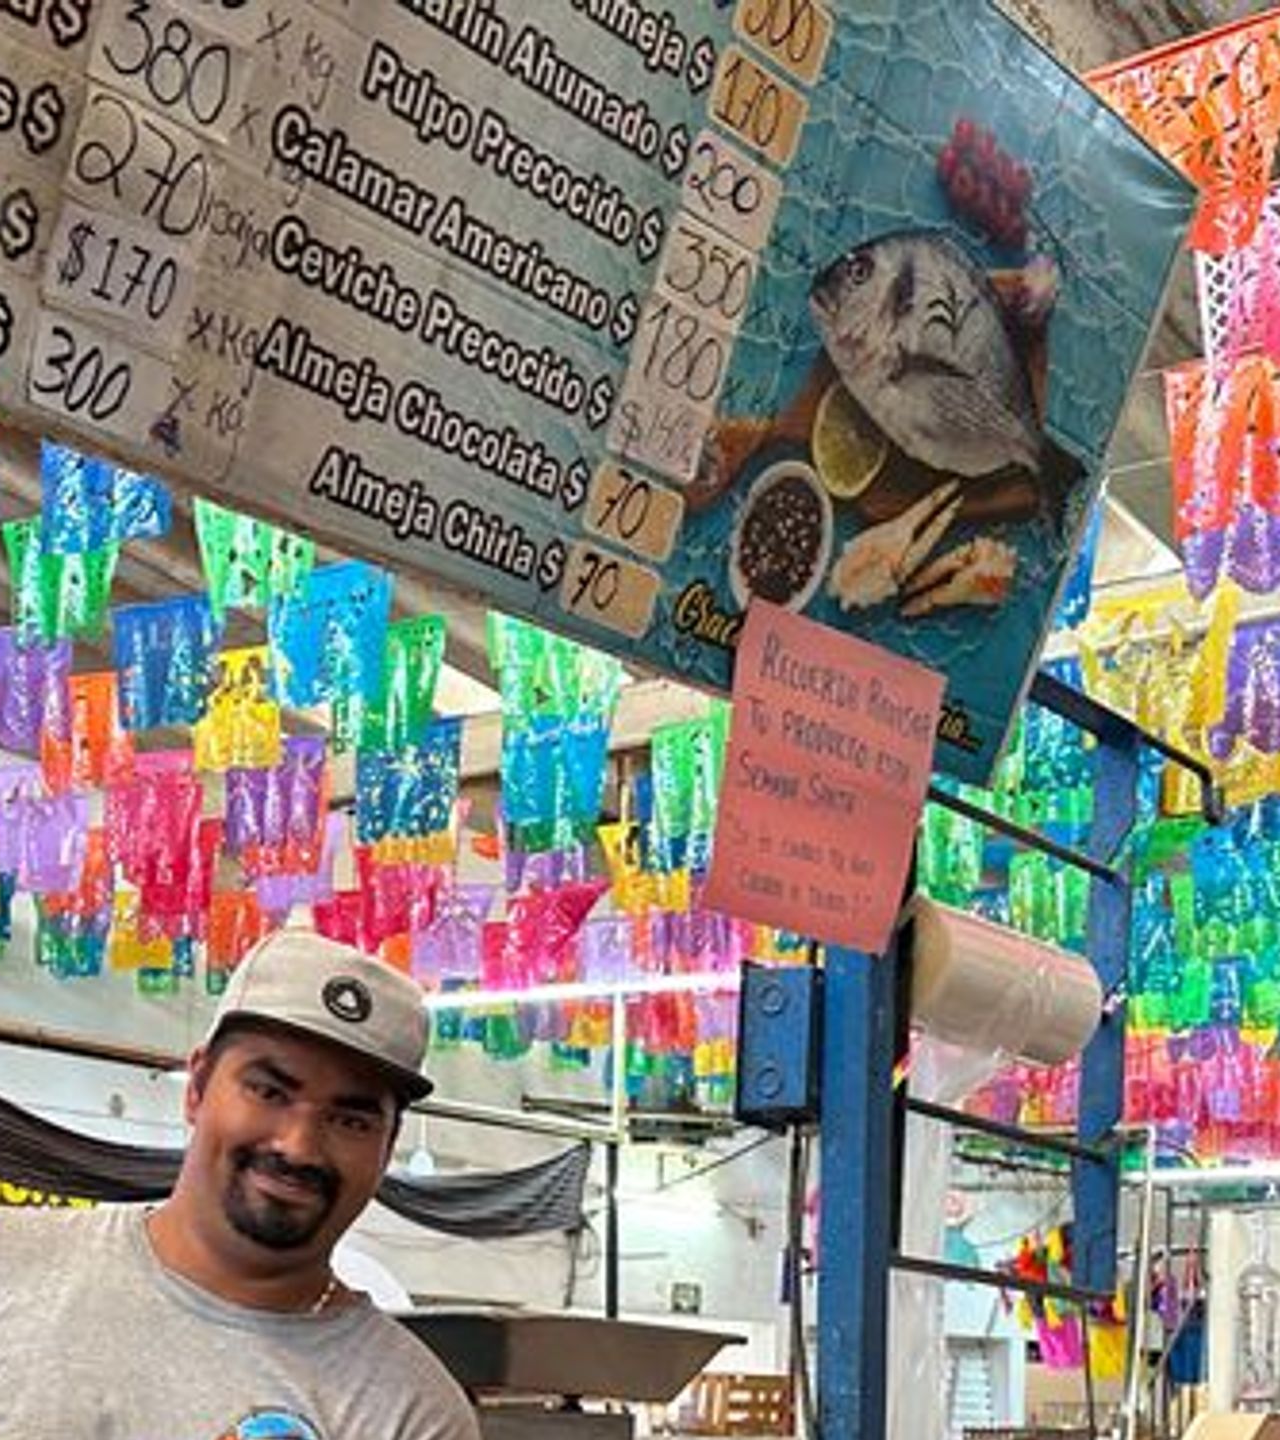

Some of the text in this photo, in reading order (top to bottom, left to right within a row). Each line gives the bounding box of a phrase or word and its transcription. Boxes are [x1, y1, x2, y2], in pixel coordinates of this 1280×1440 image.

[22, 83, 65, 153] $
[101, 2, 230, 125] 380
[397, 0, 507, 66] arlin
[503, 24, 661, 161] Ahumado
[660, 123, 690, 180] $
[686, 35, 718, 95] $
[270, 103, 437, 238] Calamar
[432, 199, 611, 330] Americano
[610, 291, 639, 348] $
[642, 301, 723, 401] 180
[361, 40, 751, 319] Pulpo Precocido $ 350
[59, 217, 178, 320] $170
[268, 214, 420, 333] Ceviche
[422, 295, 586, 417] Precocido
[586, 373, 615, 431] $
[33, 325, 131, 420] 300
[255, 318, 393, 434] Almeja
[393, 378, 563, 500] Chocolata
[561, 456, 589, 509] $
[312, 444, 442, 542] Almeja
[439, 500, 538, 586] Chirla
[536, 541, 565, 593] $
